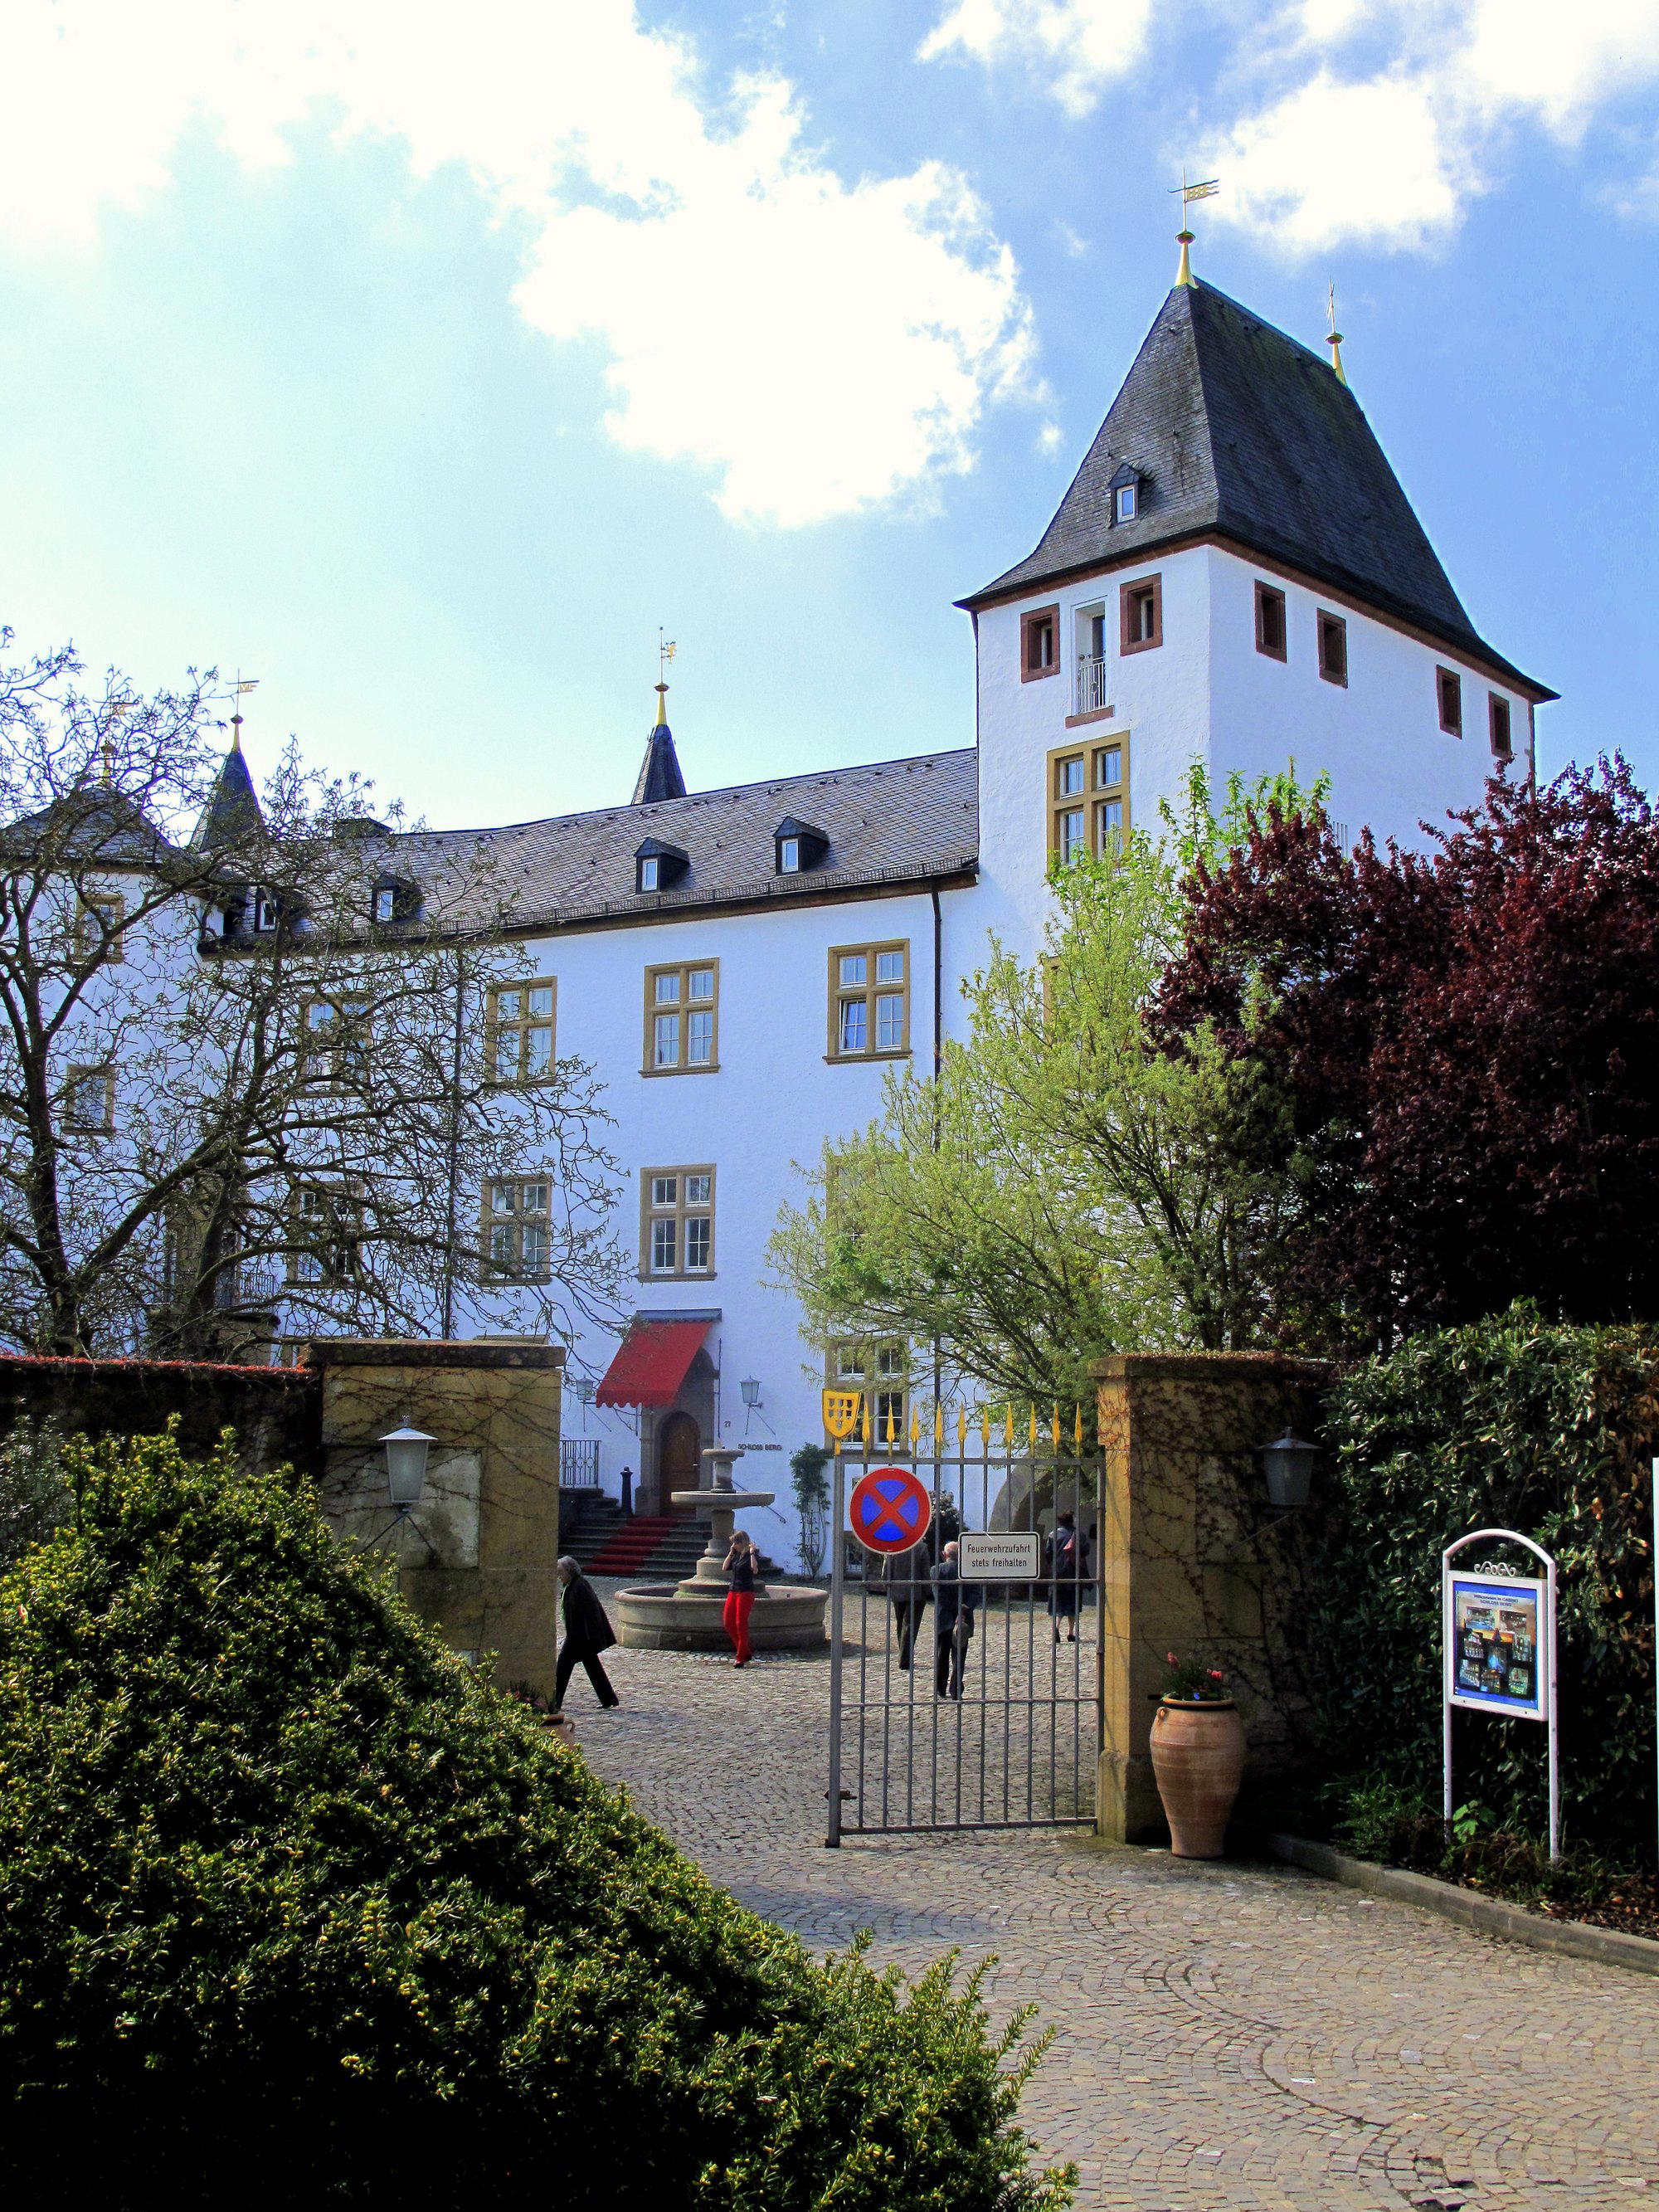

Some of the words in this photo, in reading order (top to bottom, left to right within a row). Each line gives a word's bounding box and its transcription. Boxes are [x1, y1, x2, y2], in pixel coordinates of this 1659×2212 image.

[967, 1543, 1031, 1553] Feuerwehrzufahrt
[971, 1558, 990, 1567] stets
[992, 1557, 1028, 1567] freihalten
